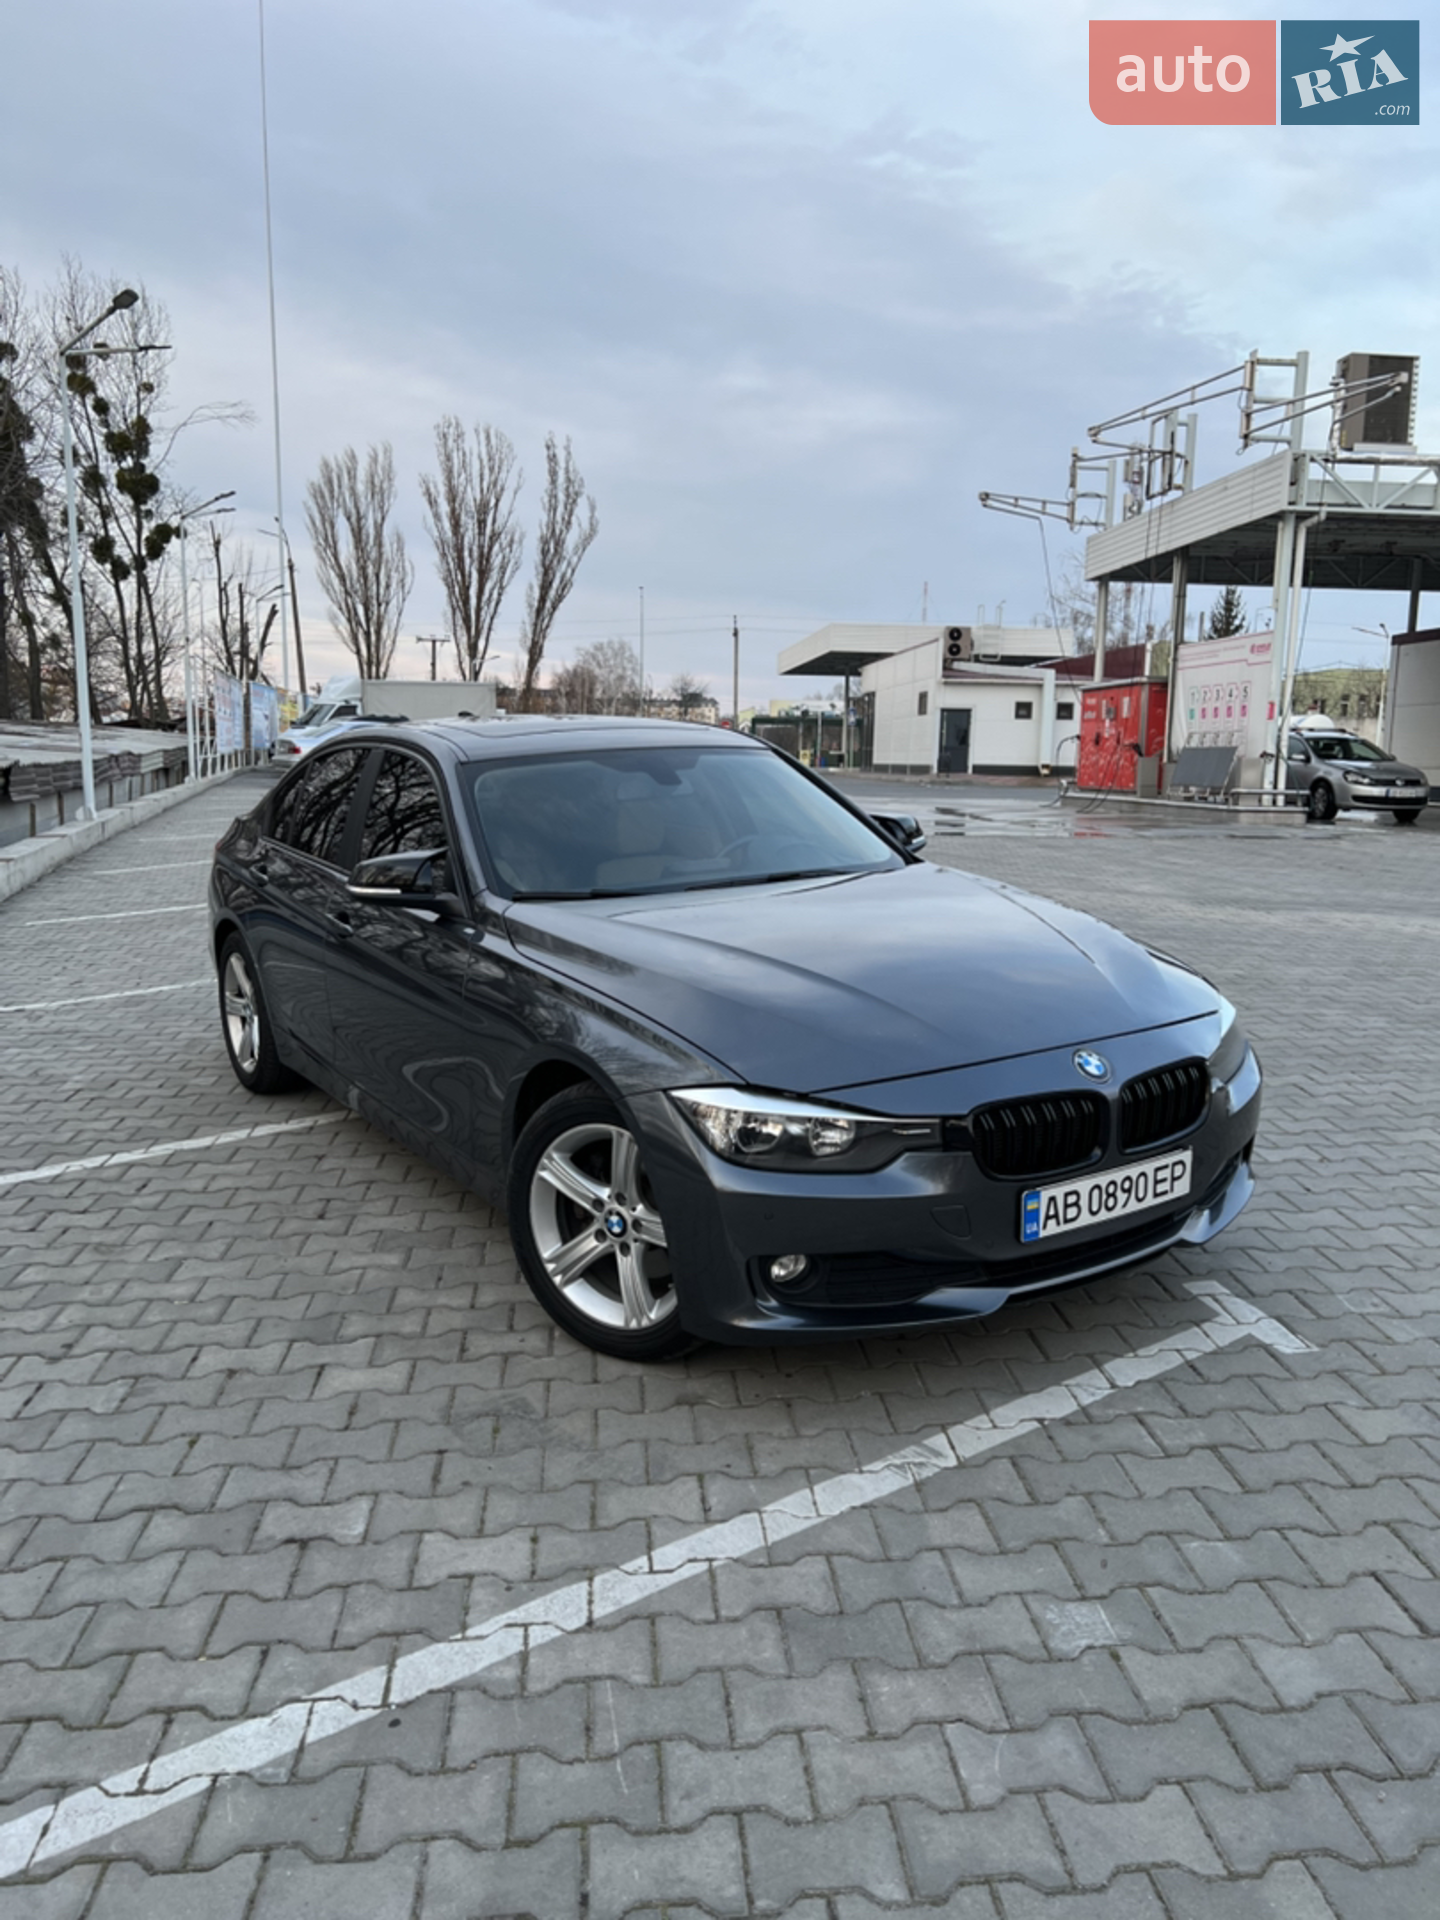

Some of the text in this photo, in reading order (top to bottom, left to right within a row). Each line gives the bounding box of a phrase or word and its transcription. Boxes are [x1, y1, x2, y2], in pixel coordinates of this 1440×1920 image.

[1042, 1159, 1187, 1231] AB 0890 EP
